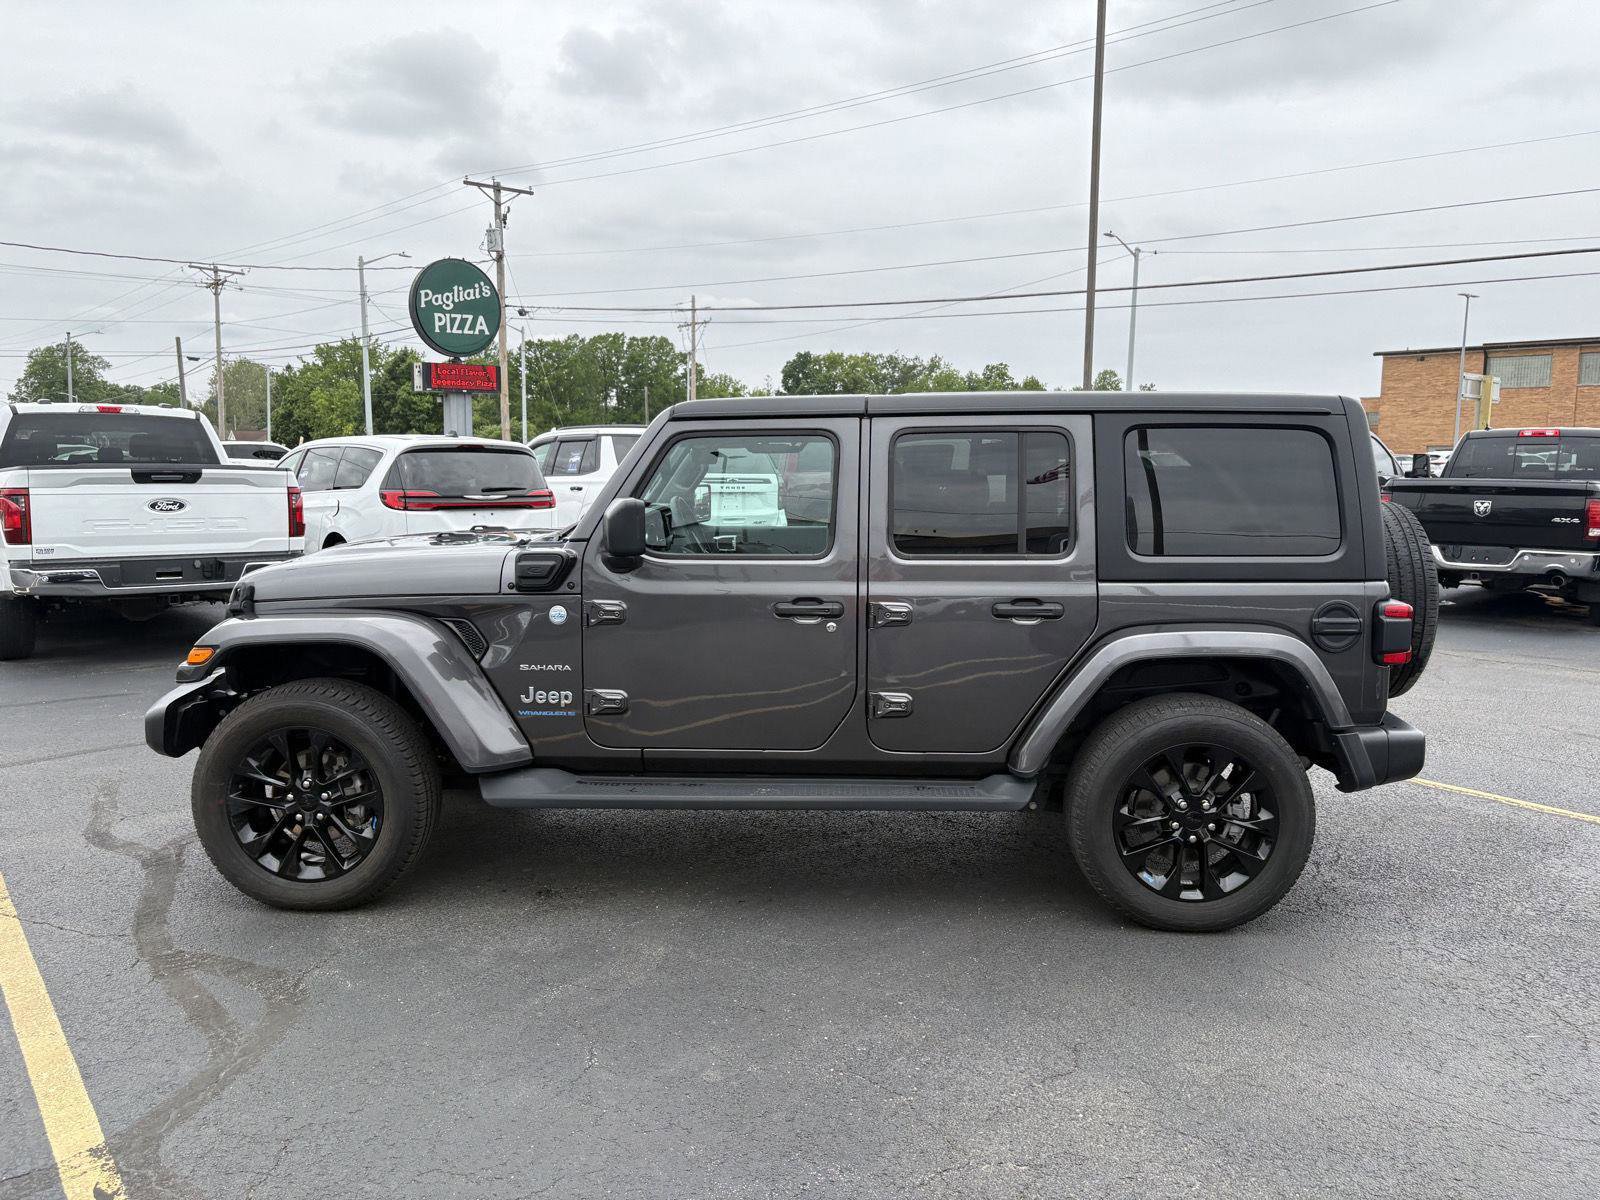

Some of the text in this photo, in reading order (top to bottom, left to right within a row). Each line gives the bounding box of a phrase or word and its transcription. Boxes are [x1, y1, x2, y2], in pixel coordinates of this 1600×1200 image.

[420, 281, 491, 310] Pagliai's
[434, 312, 490, 335] PIZZA
[437, 367, 459, 376] Local
[432, 378, 475, 388] Legendary
[154, 500, 180, 511] Ford
[520, 686, 573, 707] Jeep
